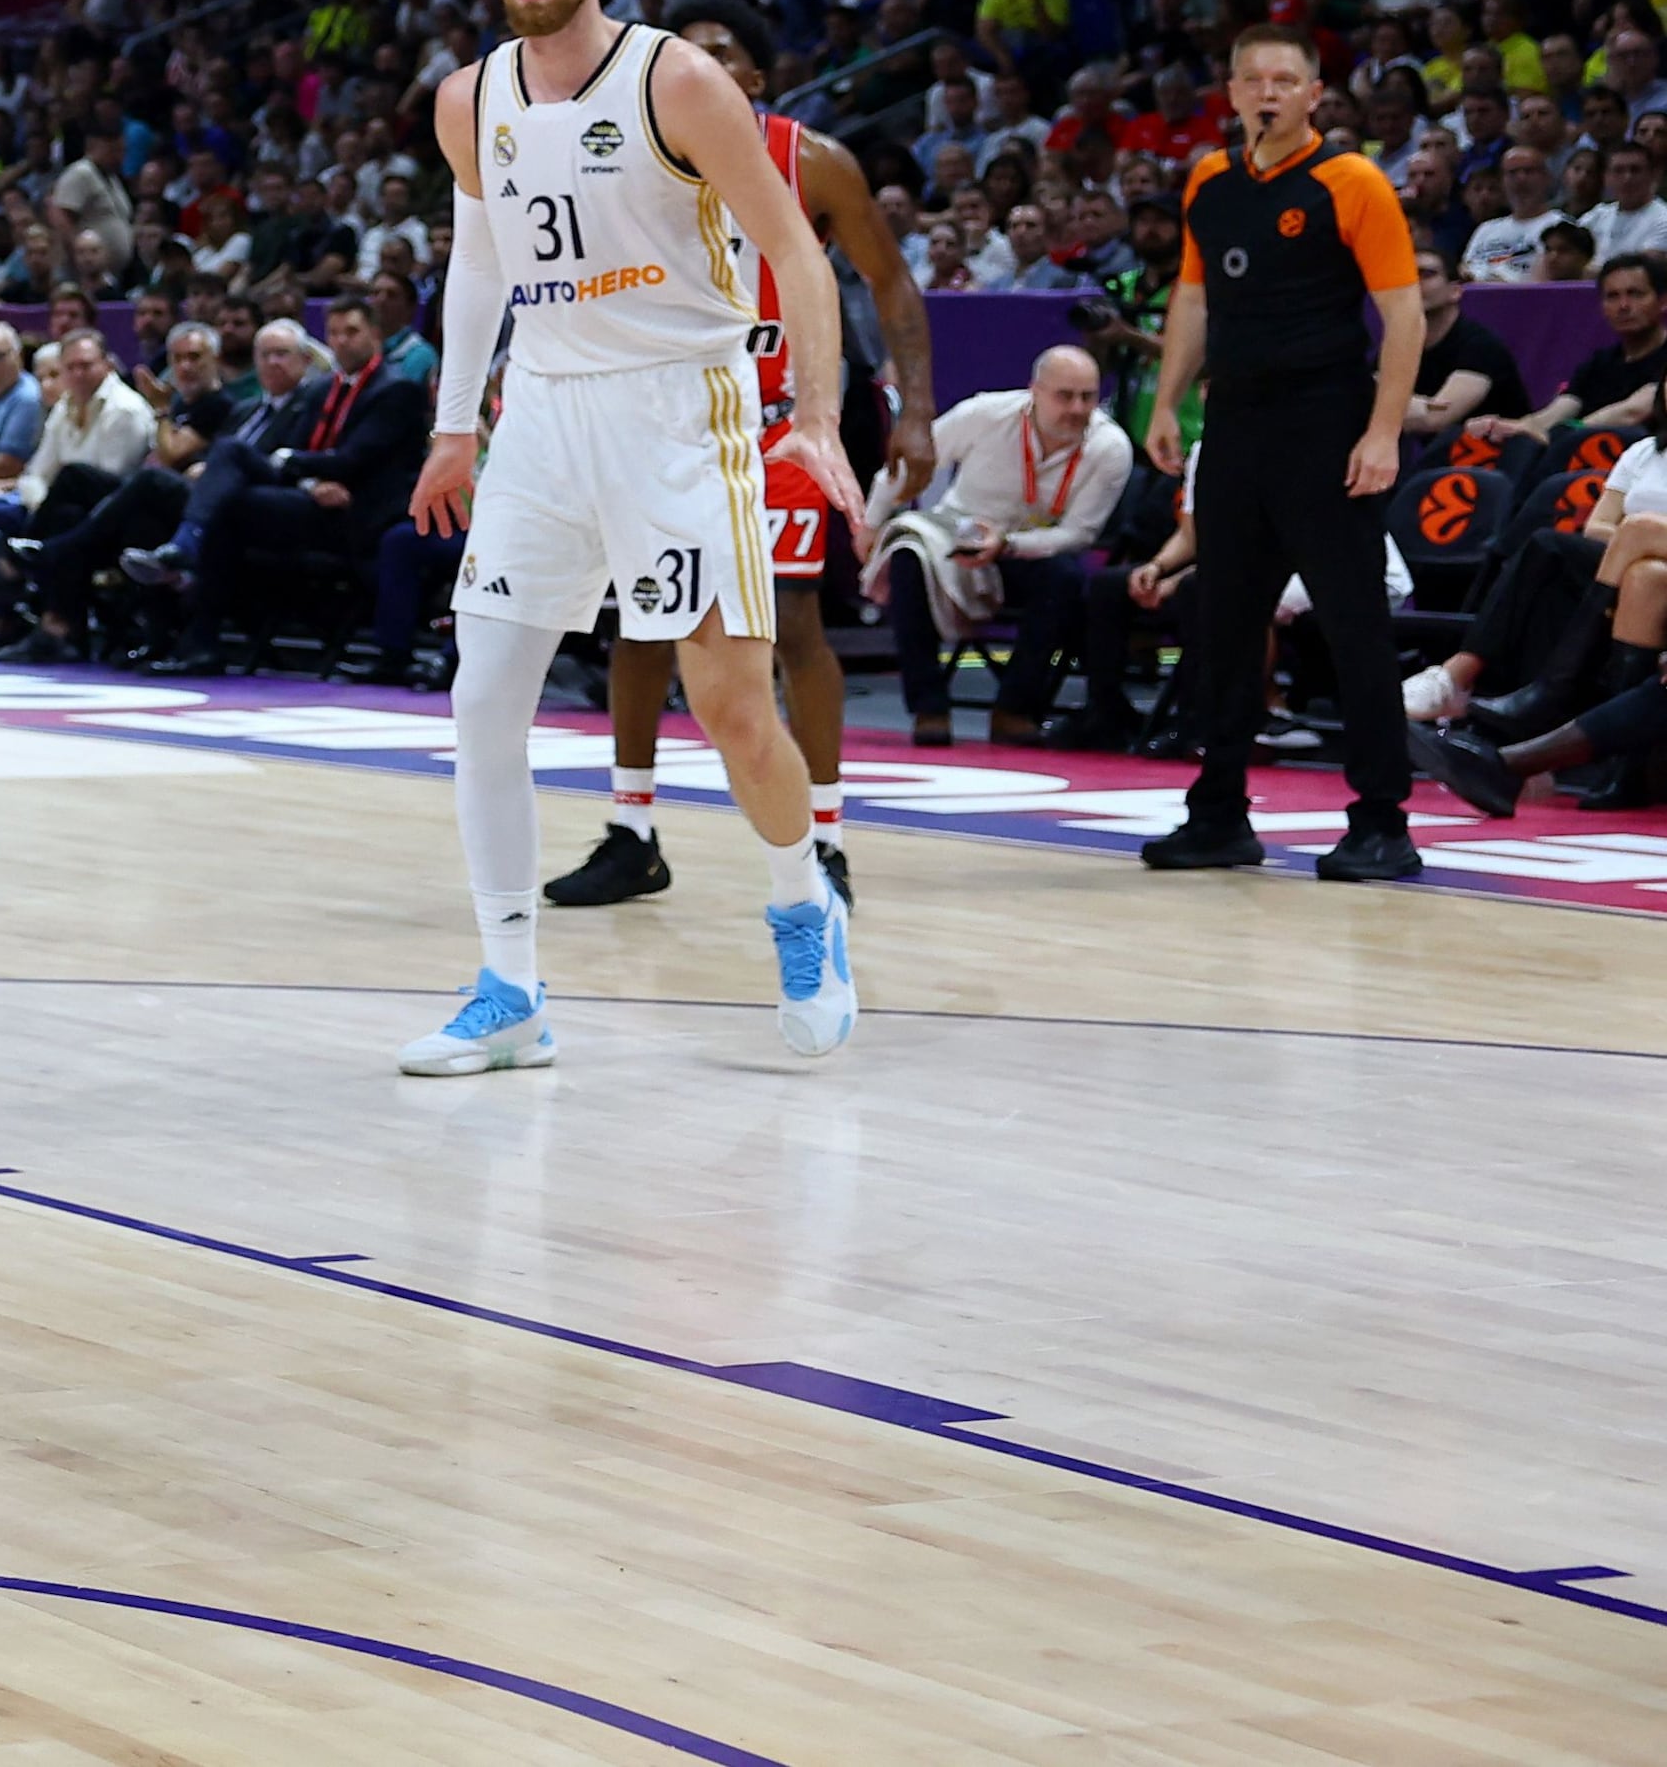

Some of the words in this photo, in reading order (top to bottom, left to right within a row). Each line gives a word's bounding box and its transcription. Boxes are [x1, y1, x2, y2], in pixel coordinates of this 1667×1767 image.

[526, 194, 586, 263] 31
[509, 264, 666, 308] AUTOHERO
[655, 547, 701, 614] 31
